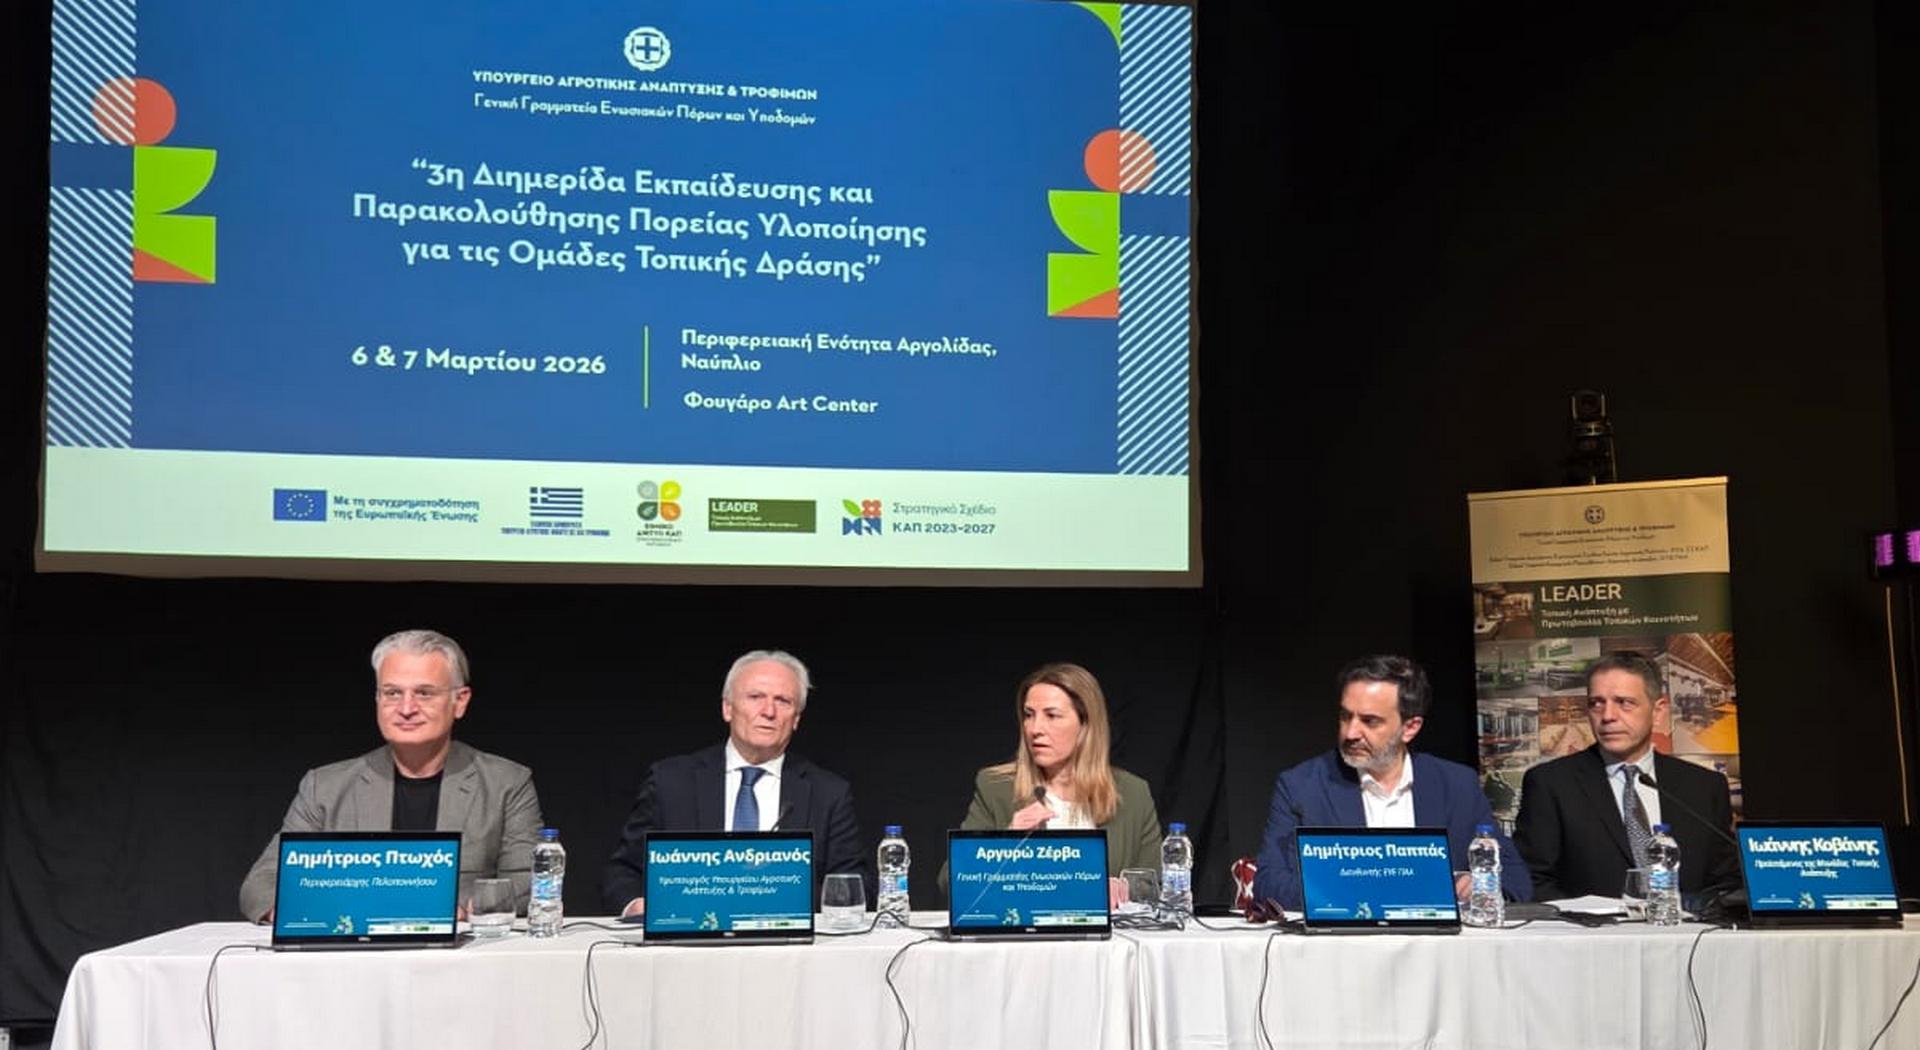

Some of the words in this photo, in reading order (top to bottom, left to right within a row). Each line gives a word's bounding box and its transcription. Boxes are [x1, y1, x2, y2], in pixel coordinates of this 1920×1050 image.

[473, 71, 554, 86] ΥΠΟΥΡΓΕΙΟ
[558, 76, 637, 91] ΑΓΡΟΤΙΚΗΣ
[640, 81, 724, 96] ΑΝΑΠΤΥΞΗΣ
[727, 86, 737, 97] &
[740, 86, 817, 100] ΤΡΟΦΙΜΩΝ
[474, 93, 518, 110] Γενική
[521, 95, 598, 115] Γραμματεία
[601, 100, 674, 117] Ενωσιακών
[677, 104, 722, 122] Πόρων
[725, 111, 745, 121] και
[748, 107, 816, 127] Υποδομών
[473, 162, 626, 195] Διημερίδα
[635, 170, 822, 206] Εκπαίδευσης
[829, 185, 874, 203] και
[353, 193, 620, 235] Παρακολούθησης
[630, 207, 749, 239] Πορείας
[758, 212, 927, 247] Υλοποίησης
[402, 242, 450, 265] για
[459, 244, 499, 267] τις
[509, 240, 626, 272] Ομάδες
[635, 245, 747, 278] Τοπικής
[682, 329, 812, 353] Περιφερειακή
[817, 333, 892, 354] Ενότητα
[897, 337, 997, 358] Αργολίδας,
[352, 346, 368, 365] 6
[375, 345, 396, 366] &
[403, 350, 418, 369] 7
[426, 348, 536, 375] Μαρτίου
[543, 355, 606, 374] 2026
[682, 353, 761, 371] Ναύπλιο
[684, 391, 772, 413] Φουγάρο
[777, 395, 807, 411] Art
[813, 395, 878, 413] Center
[334, 496, 348, 505] Με
[353, 498, 365, 507] τη
[369, 498, 480, 511] συγχρηματοδότηση
[712, 501, 759, 513] LEADER
[893, 502, 957, 516] Στρατηγικό
[959, 503, 996, 517] Σχέδιο
[334, 510, 352, 520] της
[430, 511, 478, 522] Ένωσης
[893, 522, 922, 533] ΚΑΠ
[924, 522, 996, 534] 2023-2027
[1540, 583, 1622, 603] LEADER
[976, 846, 1034, 863] Αργυρώ
[1036, 846, 1081, 863] Ζέρβα
[1303, 842, 1384, 860] Δημήτριος
[1385, 842, 1447, 859] Παππάς
[1748, 836, 1813, 856] Ιωάννης
[1812, 836, 1880, 856] Κοβάνης
[286, 849, 381, 868] Δημήτριος
[385, 849, 453, 868] Πτωχός
[649, 848, 721, 867] Ιωάννης
[724, 848, 810, 866] Ανδριανός
